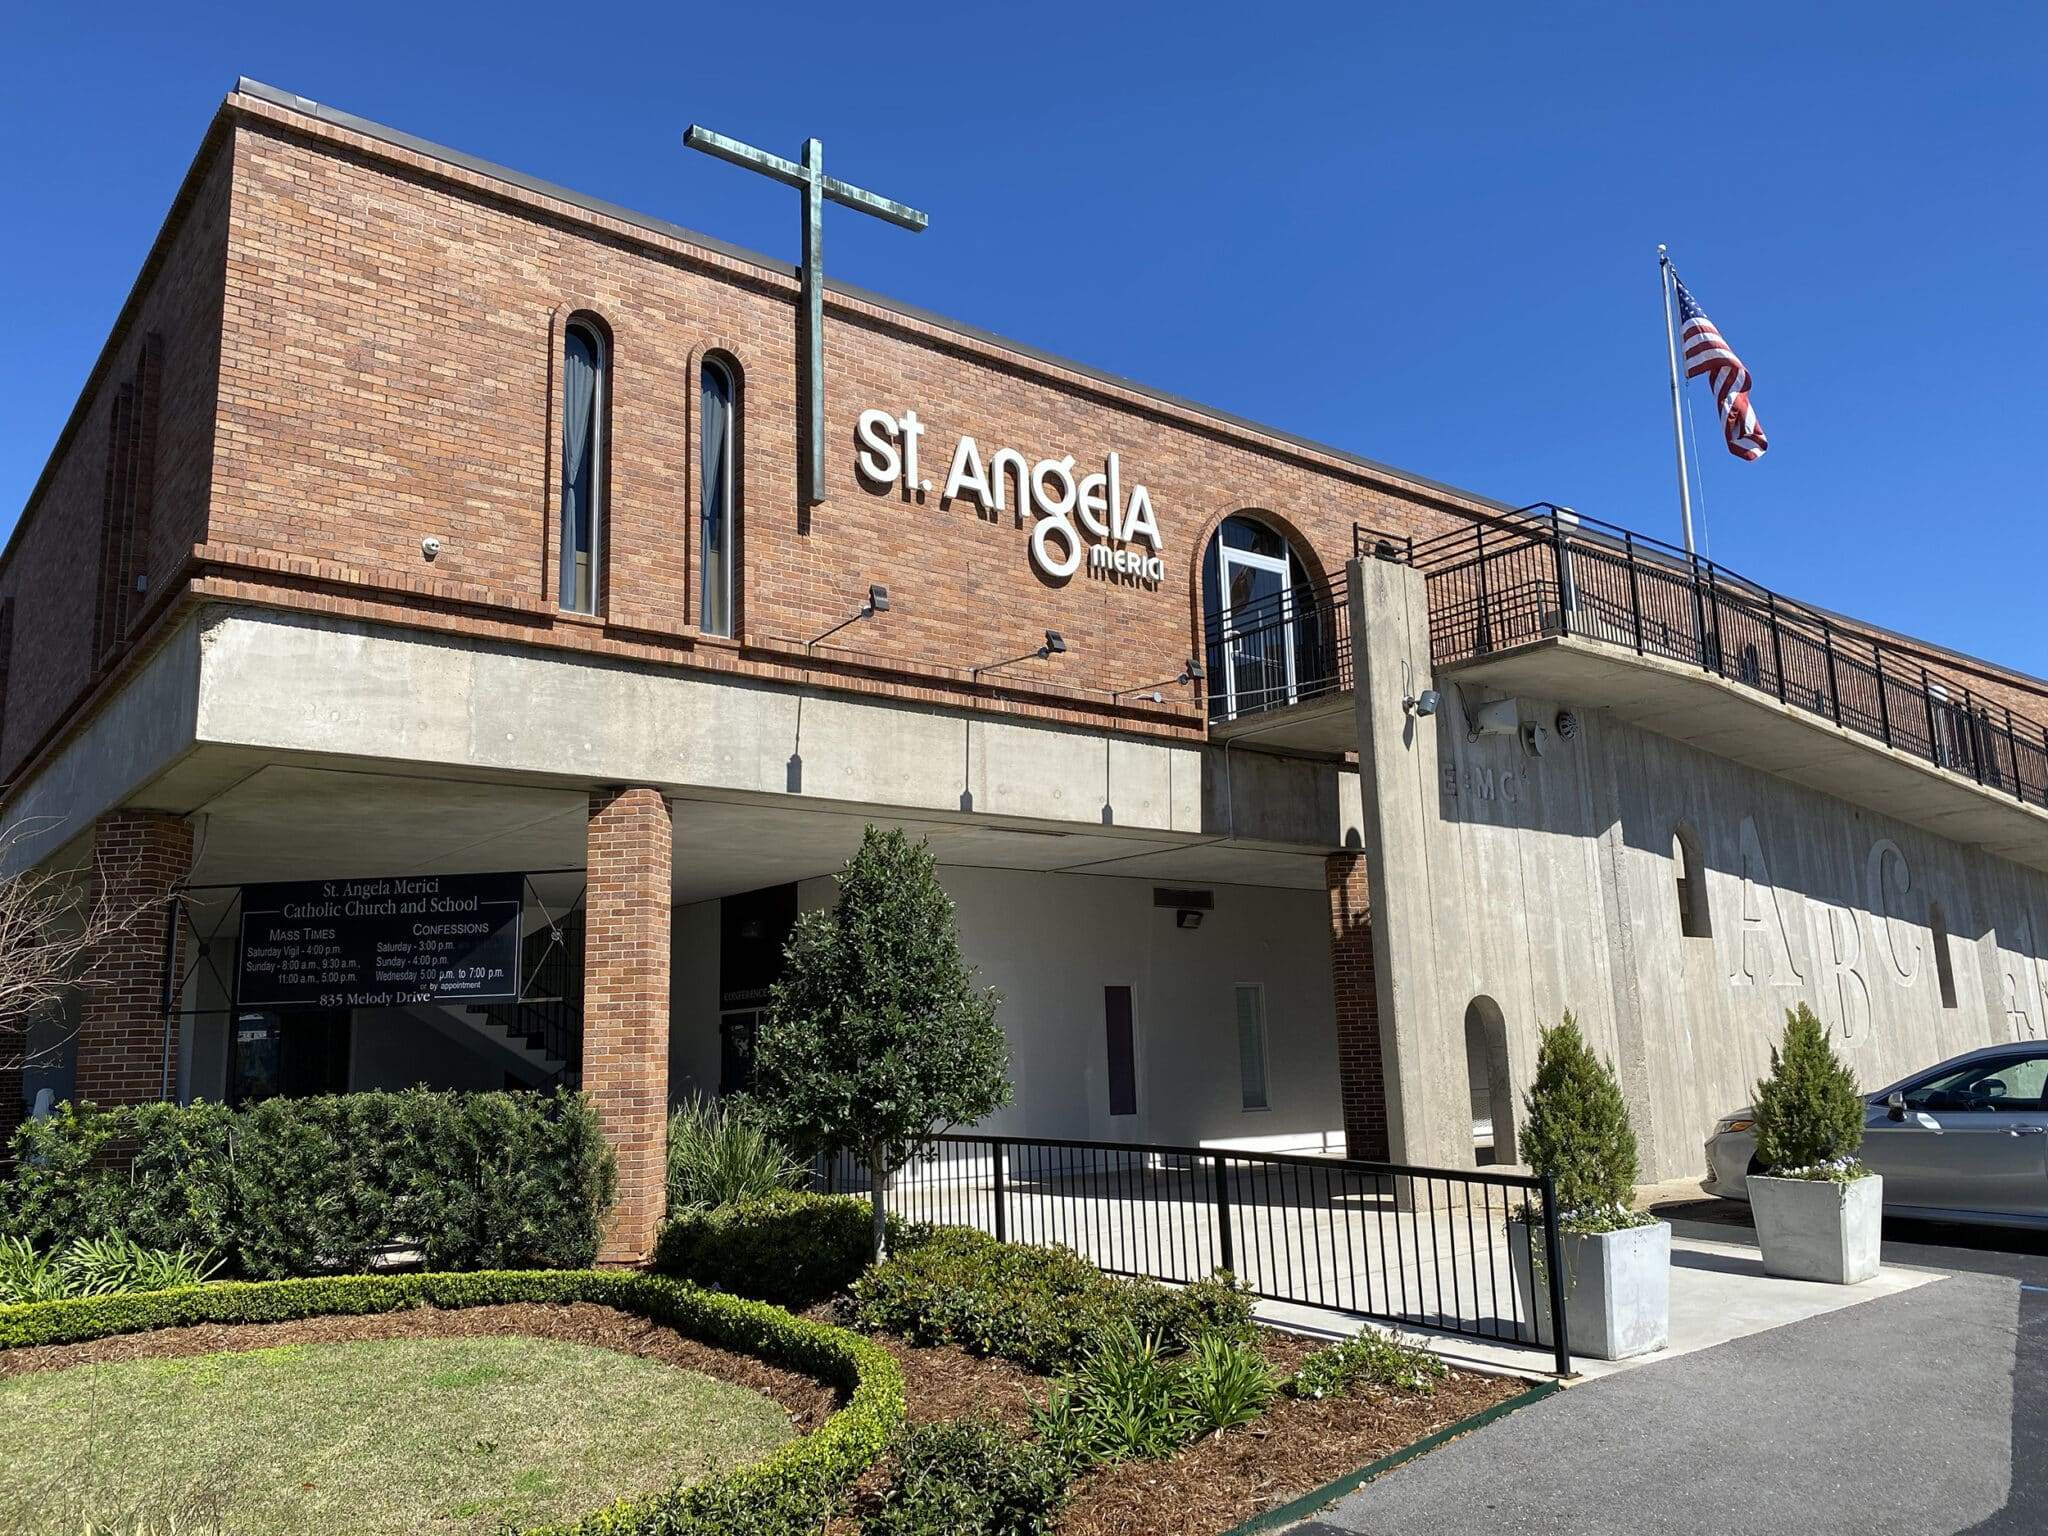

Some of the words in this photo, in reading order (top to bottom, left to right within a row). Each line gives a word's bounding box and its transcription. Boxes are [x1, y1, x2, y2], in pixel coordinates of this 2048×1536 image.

[857, 409, 933, 491] St.
[323, 882, 339, 898] St.
[343, 880, 390, 899] Angela
[394, 879, 439, 894] Merici
[284, 902, 341, 919] Catholic
[345, 900, 397, 916] Church
[400, 897, 426, 913] and
[430, 896, 478, 912] School
[247, 946, 281, 958] Saturday
[283, 945, 300, 958] Vigil
[306, 944, 324, 955] 4:00
[377, 942, 412, 953] Saturday
[419, 941, 436, 950] 3:00
[438, 942, 455, 951] p.m.
[246, 961, 276, 972] Sunday
[282, 960, 299, 970] 8:00
[322, 959, 340, 969] 9:30
[376, 956, 405, 967] Sunday
[412, 956, 430, 965] 4:00
[278, 974, 298, 984] 11:00
[321, 972, 338, 982] 5:00
[376, 971, 417, 982] Wednesday
[420, 970, 436, 980] 5:00
[439, 971, 456, 981] p.m.
[458, 969, 466, 978] to
[470, 967, 486, 978] 7:00
[488, 969, 504, 980] p.m.
[429, 981, 439, 992] by
[441, 981, 481, 991] appointment
[320, 994, 343, 1007] 835
[347, 992, 392, 1008] Melody
[396, 992, 431, 1004] Drive
